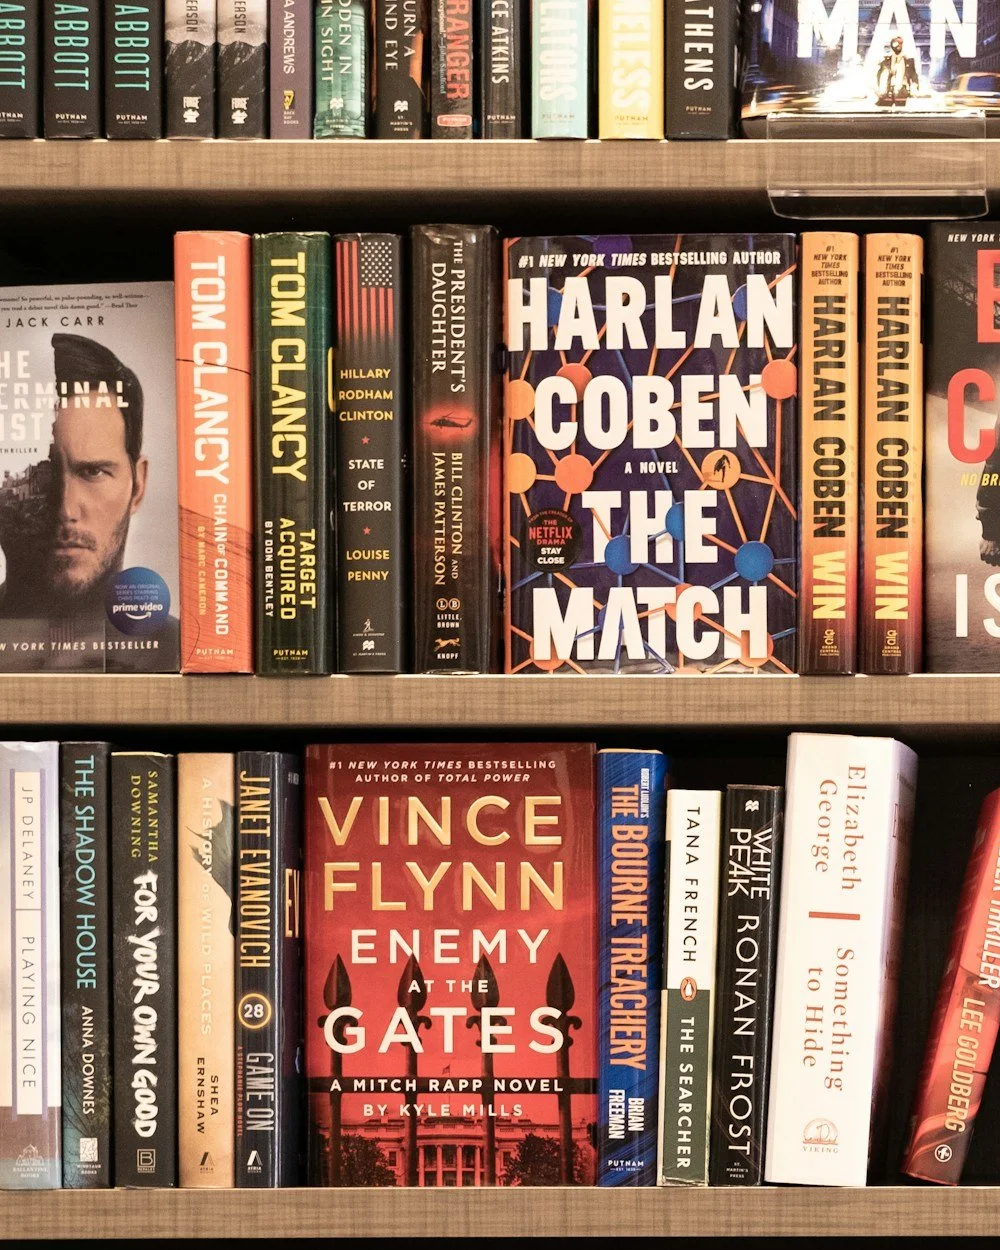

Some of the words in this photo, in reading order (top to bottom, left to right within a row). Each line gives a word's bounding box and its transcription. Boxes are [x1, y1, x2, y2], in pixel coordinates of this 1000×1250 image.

[54, 4, 89, 91] ABBOTT
[115, 4, 150, 91] ABBOTT
[491, 25, 510, 84] ATKINS
[7, 315, 49, 328] JACK
[61, 314, 105, 327] CARR
[190, 256, 225, 331] TOM
[508, 274, 794, 352] HARLAN
[340, 369, 391, 380] HILLARY
[813, 295, 846, 421] HARLAN
[194, 339, 229, 485] CLANCY
[339, 390, 393, 400] RODHAM
[339, 411, 393, 421] CLINTON
[534, 374, 767, 450] COBEN
[348, 458, 384, 469] STATE
[357, 480, 375, 490] OF
[624, 463, 633, 474] A
[639, 462, 678, 474] NOVEL
[813, 436, 846, 539] COBEN
[961, 473, 977, 486] NO
[213, 494, 226, 539] CHAIN
[342, 501, 392, 511] TERROR
[582, 488, 718, 564] THE
[214, 556, 229, 635] COMMAND
[812, 551, 846, 619] WIN
[532, 585, 769, 663] MATCH
[75, 755, 95, 797] THE
[240, 771, 270, 837] JANET
[318, 795, 563, 846] VINCE
[685, 807, 699, 865] TANA
[75, 804, 95, 906] SHADOW
[240, 845, 271, 969] EVANOVICH
[324, 861, 564, 912] FLYNN
[351, 929, 549, 965] ENEMY
[683, 877, 697, 963] FRENCH
[76, 915, 97, 990] HOUSE
[408, 979, 438, 993] AT
[446, 979, 489, 993] THE
[323, 1006, 565, 1055] GATES
[680, 1016, 693, 1053] THE
[330, 1079, 342, 1092] A
[352, 1078, 416, 1092] MITCH
[429, 1078, 483, 1092] RAPP
[494, 1078, 564, 1091] NOVEL
[363, 1104, 388, 1117] BY
[399, 1104, 450, 1117] KYLE
[463, 1104, 523, 1117] MILLS
[678, 1062, 692, 1169] SEARCHER
